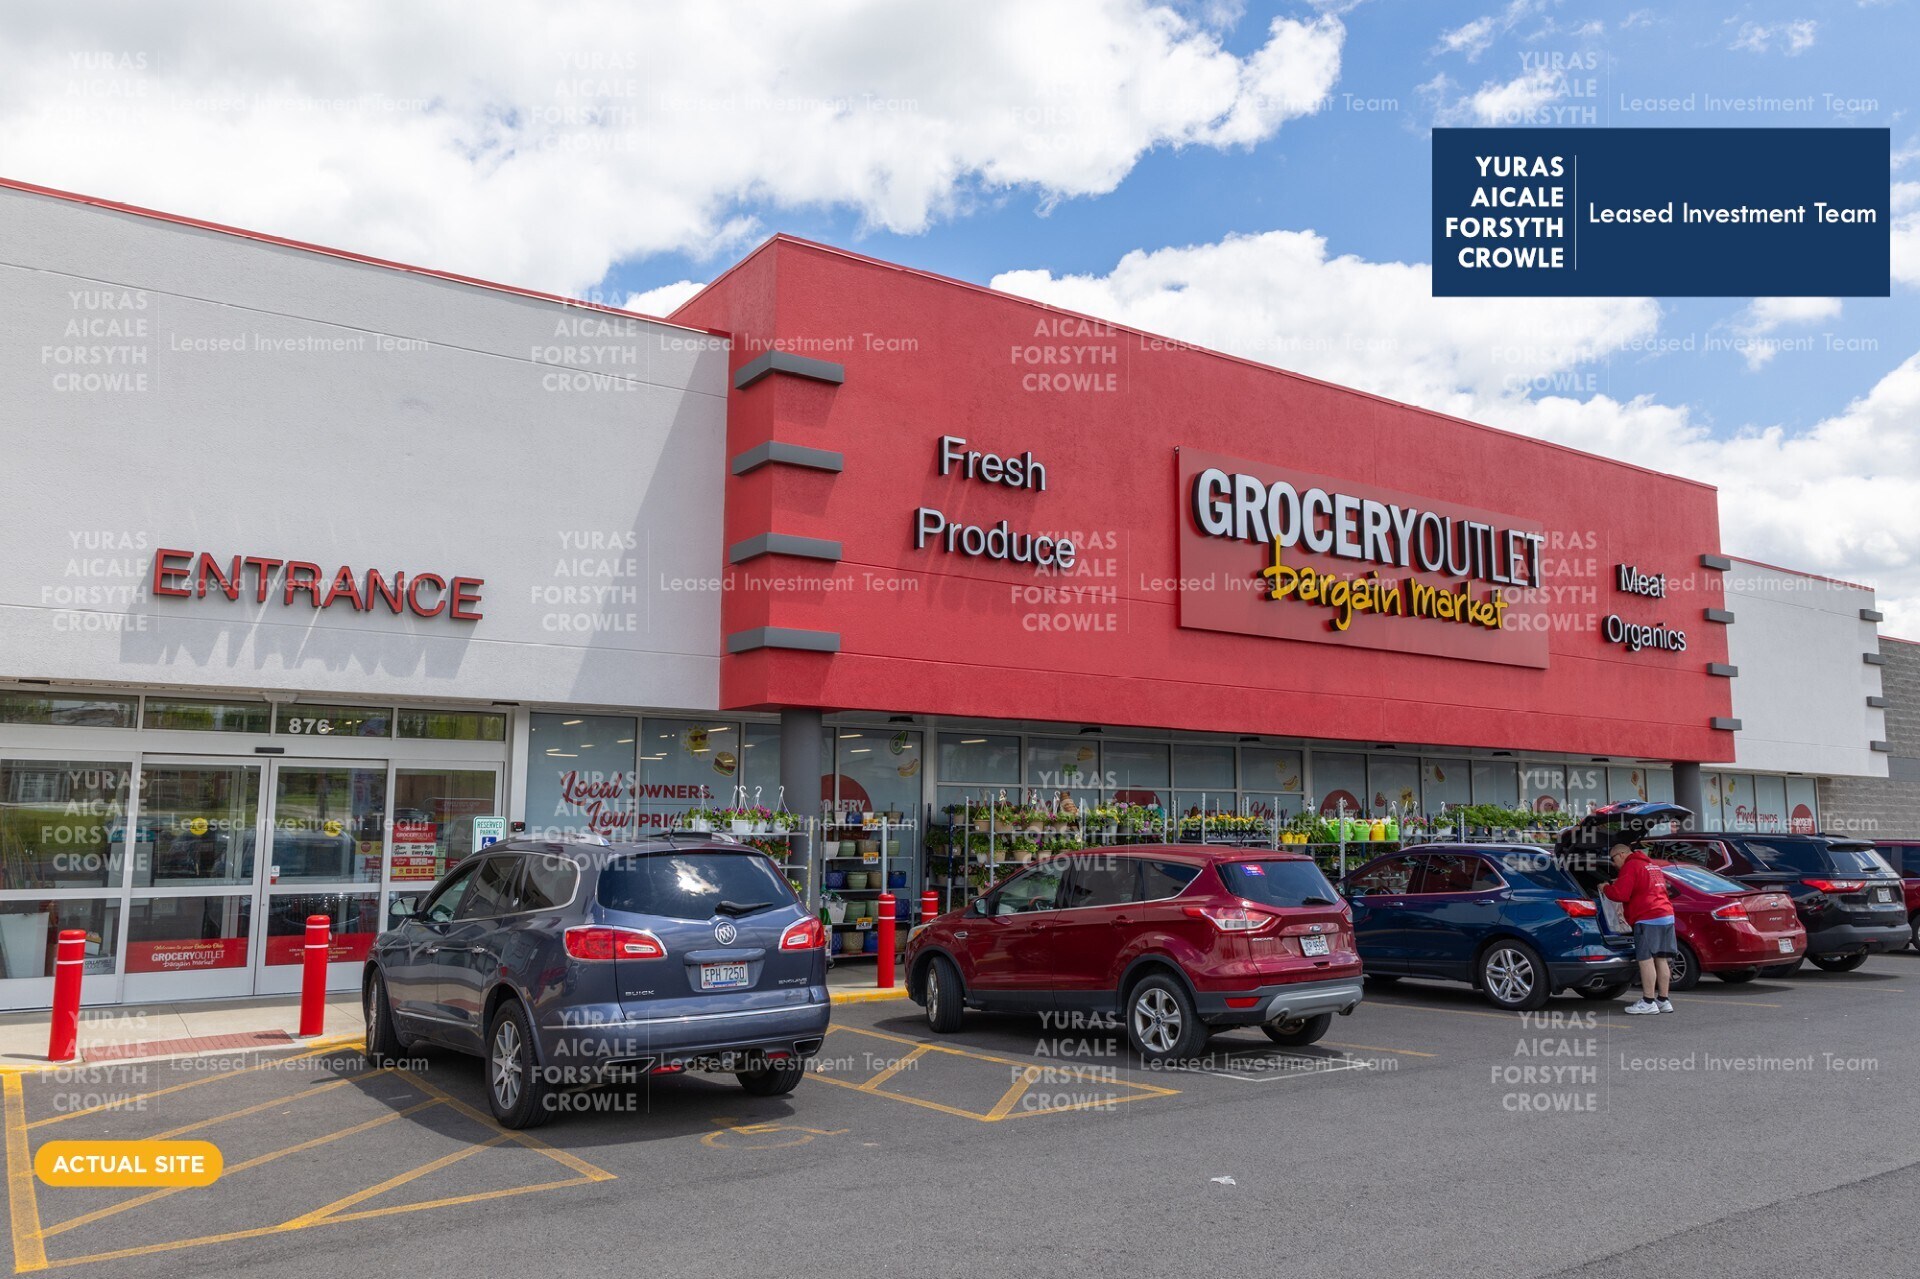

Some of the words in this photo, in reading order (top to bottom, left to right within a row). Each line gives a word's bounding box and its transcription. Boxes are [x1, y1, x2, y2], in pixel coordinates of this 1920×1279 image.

[939, 435, 1047, 491] Fresh
[914, 507, 1076, 569] Produce
[1193, 467, 1545, 588] GROCERYOUTLET
[152, 547, 484, 621] ENTRANCE
[1262, 534, 1402, 631] bargain
[1405, 577, 1509, 630] market
[1616, 563, 1667, 599] Meat
[1602, 614, 1687, 653] Organics
[288, 717, 331, 736] 876
[560, 770, 623, 806] Local
[477, 821, 502, 829] RESERVED
[586, 800, 633, 836] Low
[1735, 804, 1757, 824] Fresh
[1758, 813, 1779, 824] FINDS
[151, 949, 225, 962] GROCERYOUTLET
[163, 960, 191, 969] bargain
[704, 968, 722, 982] EPH
[723, 966, 745, 981] 7250
[624, 989, 655, 997] BUICK
